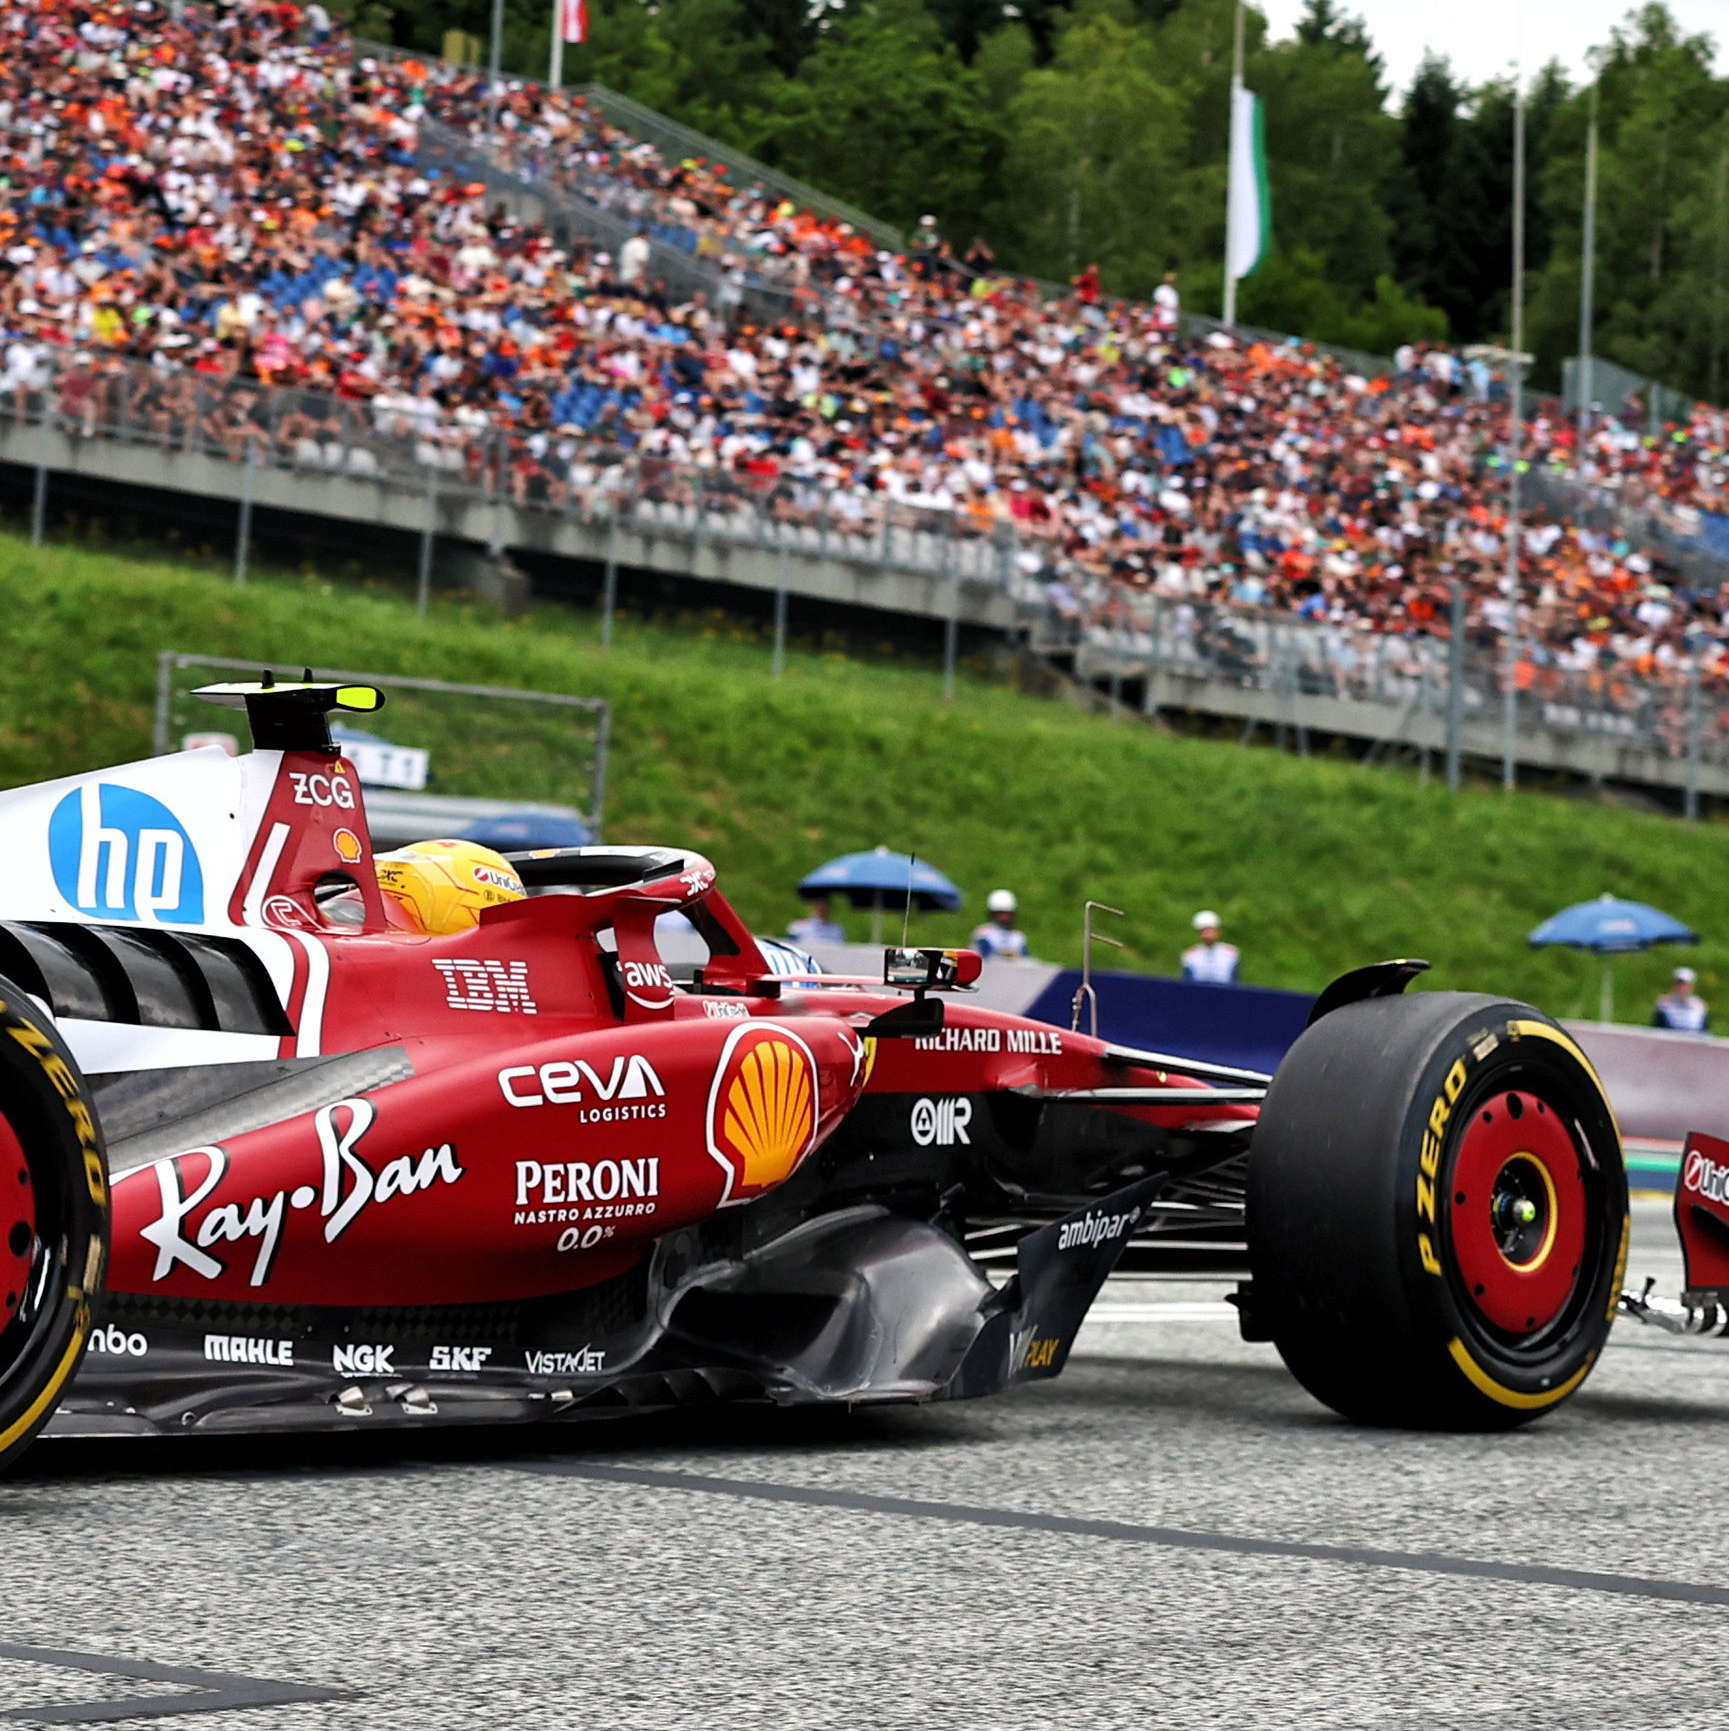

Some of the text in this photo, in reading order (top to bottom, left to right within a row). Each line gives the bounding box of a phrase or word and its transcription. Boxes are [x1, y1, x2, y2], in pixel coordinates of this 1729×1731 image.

[289, 772, 355, 809] ZCG
[76, 782, 185, 922] hp
[431, 958, 538, 1015] IBM
[624, 961, 674, 989] aws
[1007, 1029, 1064, 1056] MILLE
[579, 1103, 667, 1124] LOGISTICS
[1416, 1057, 1468, 1224] ZERO
[515, 1157, 660, 1206] PERONI
[514, 1201, 656, 1225] NASTRO AZZURRO
[1057, 1208, 1130, 1251] ambipar
[203, 1333, 295, 1366] MAHLE
[332, 1344, 395, 1374] NGK
[428, 1345, 493, 1371] SKF
